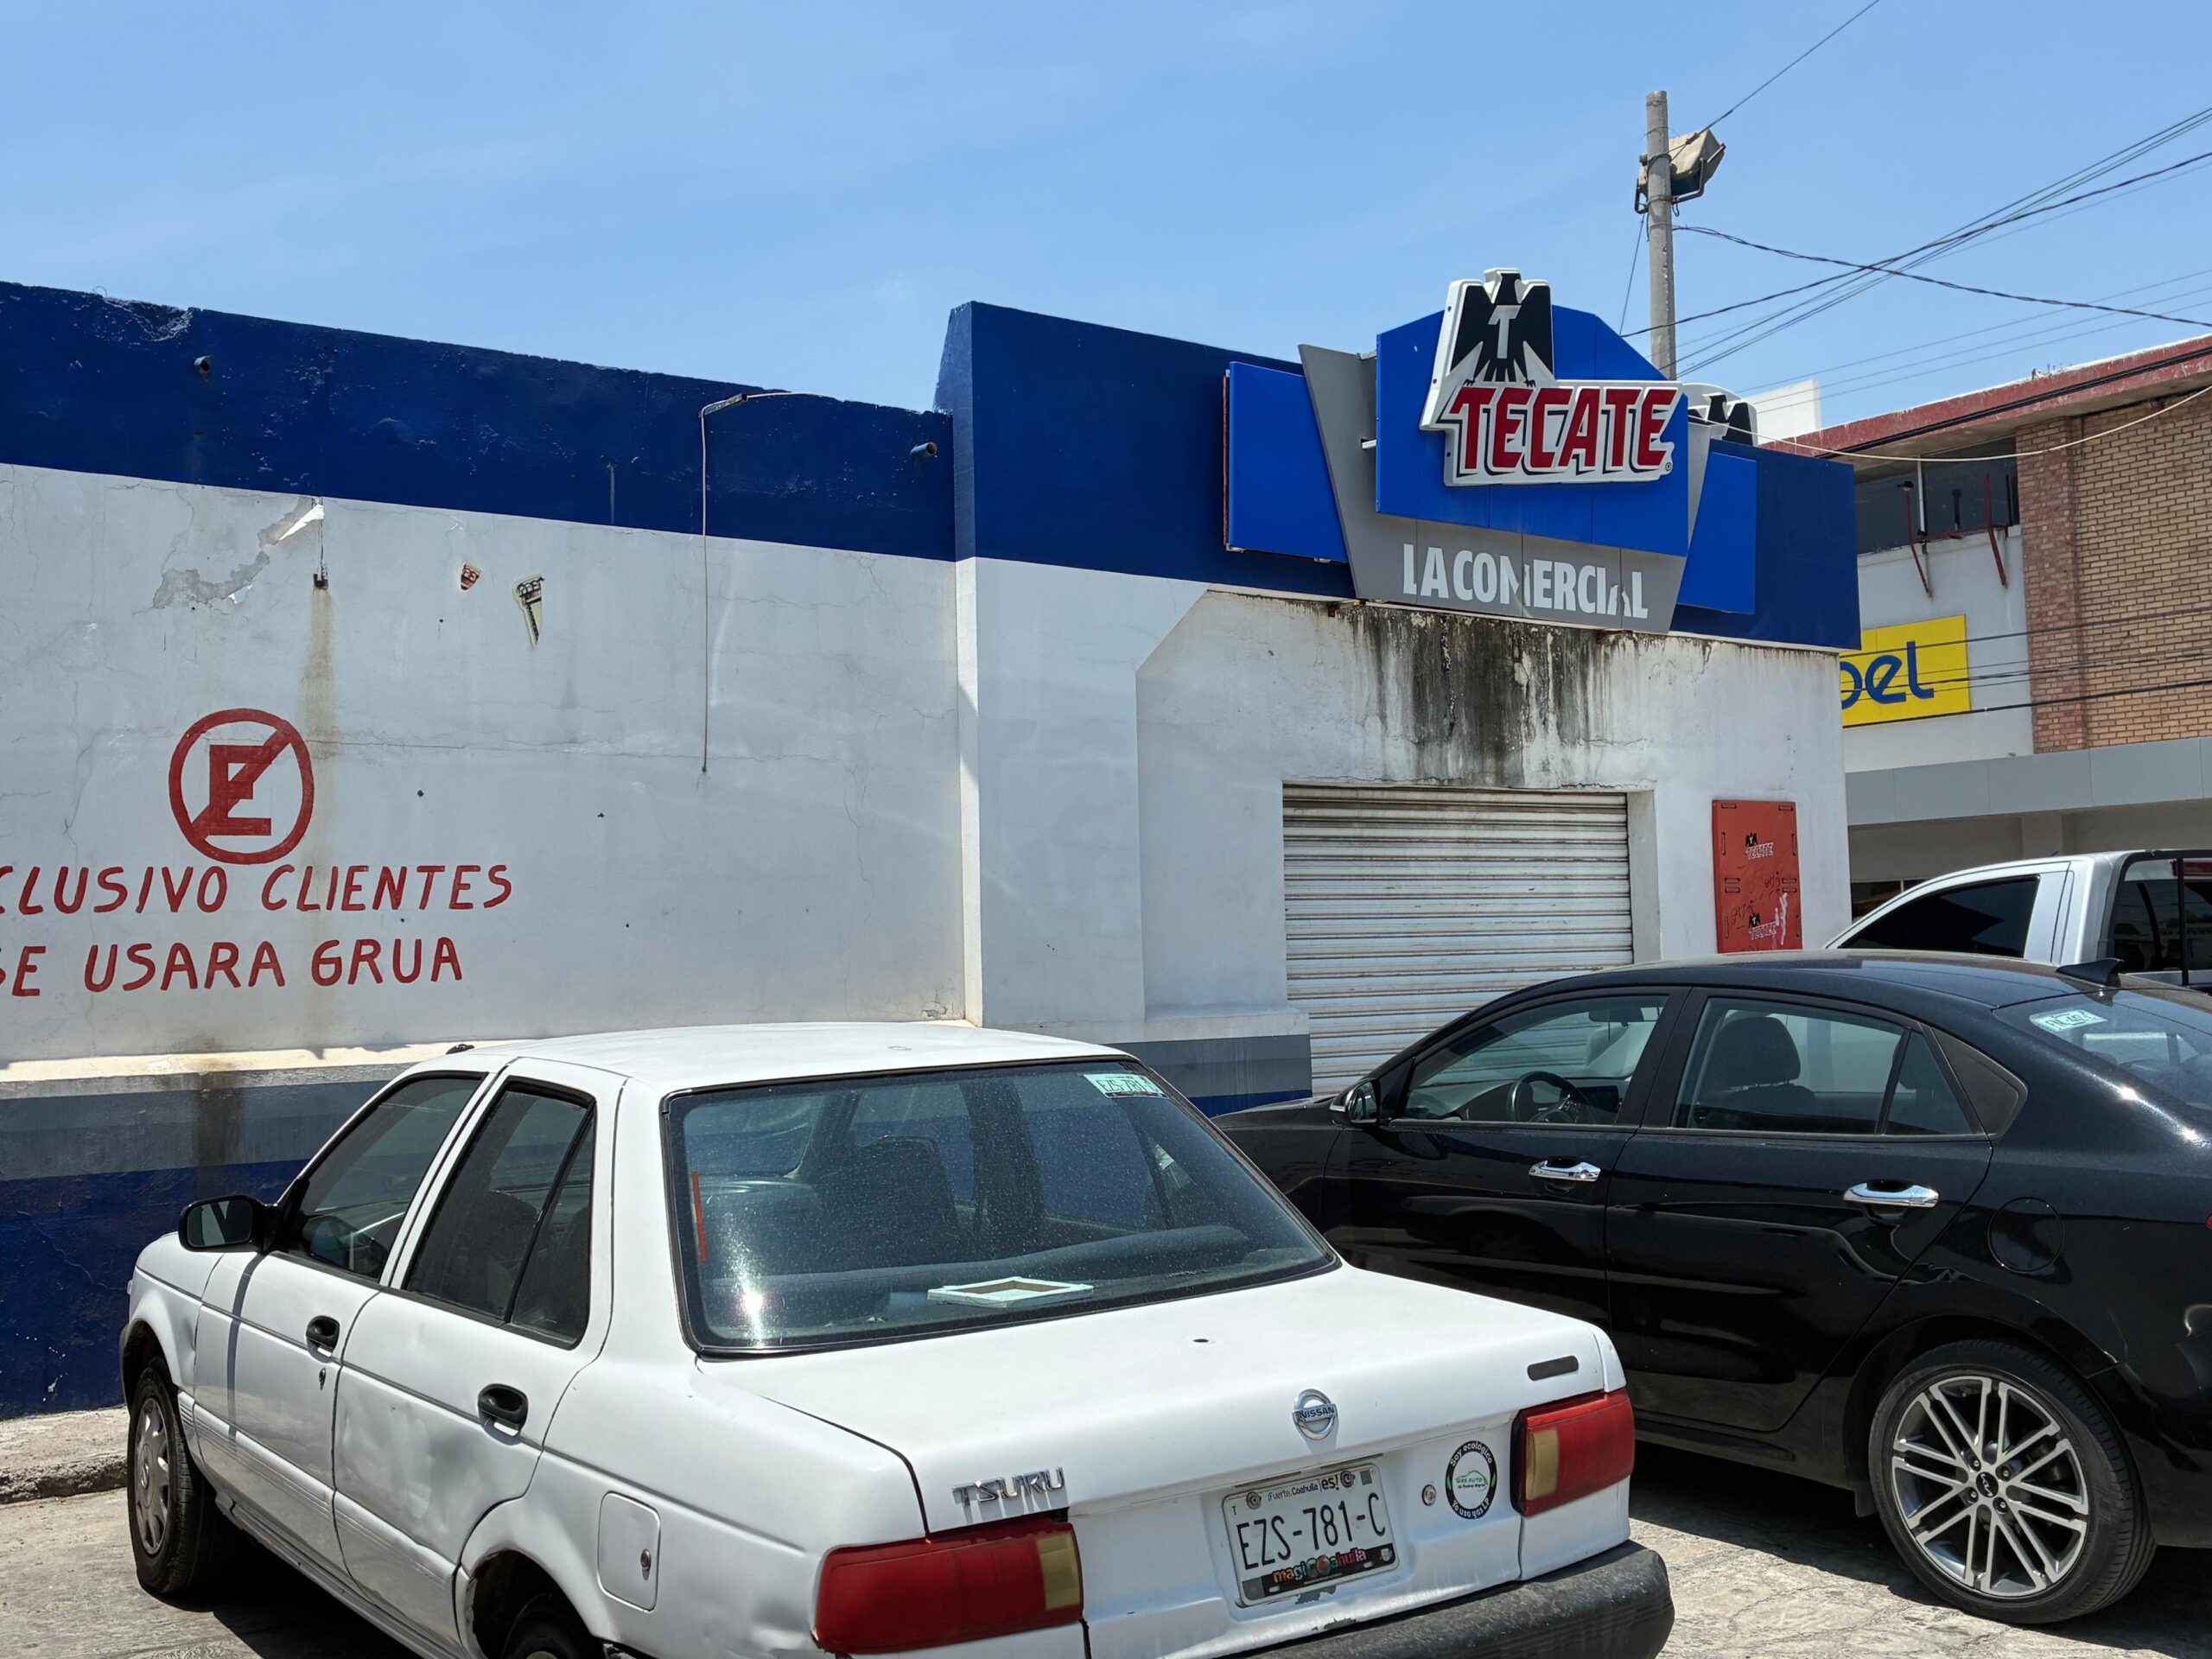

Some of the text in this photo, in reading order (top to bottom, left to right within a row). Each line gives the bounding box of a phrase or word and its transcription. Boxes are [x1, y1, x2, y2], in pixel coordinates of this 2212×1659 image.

[1446, 385, 1679, 473] TECATE
[262, 864, 512, 912] CLIENTES
[0, 937, 462, 997] E USARA GRUA
[1299, 1406, 1335, 1419] NISSAN
[1450, 1449, 1462, 1466] Soy
[951, 1466, 1065, 1507] TSURU
[1236, 1492, 1386, 1571] EZS-781-C
